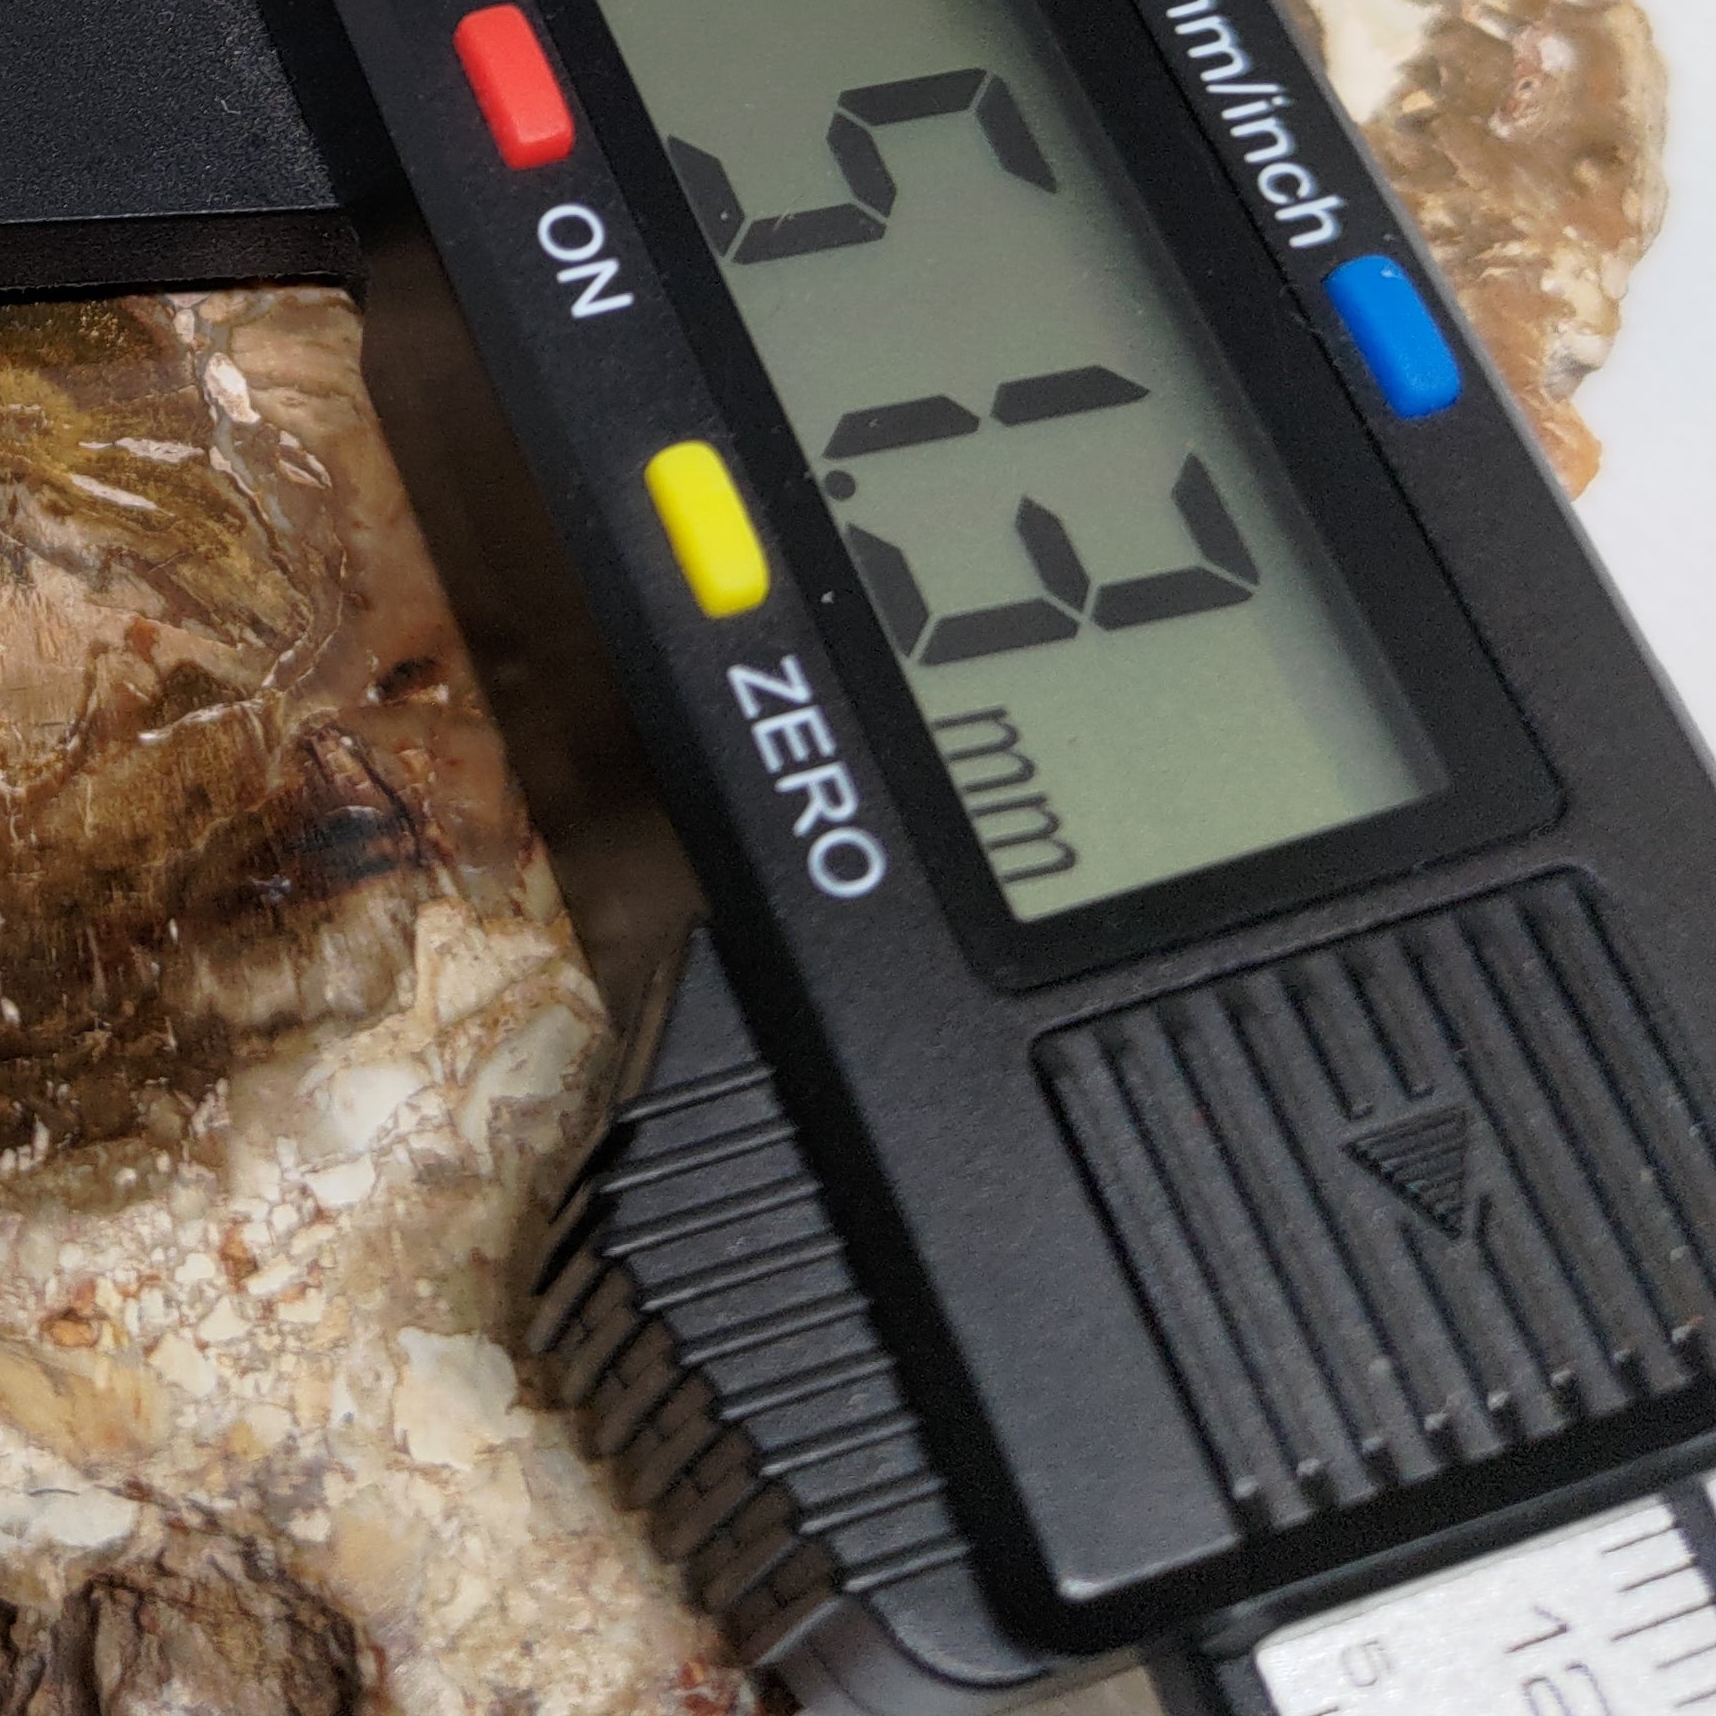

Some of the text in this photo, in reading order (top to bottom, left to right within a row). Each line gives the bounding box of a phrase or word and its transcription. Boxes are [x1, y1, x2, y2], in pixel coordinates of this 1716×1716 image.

[537, 204, 635, 320] ON
[667, 67, 1262, 884] 51.3 mm
[726, 655, 887, 898] ZERO
